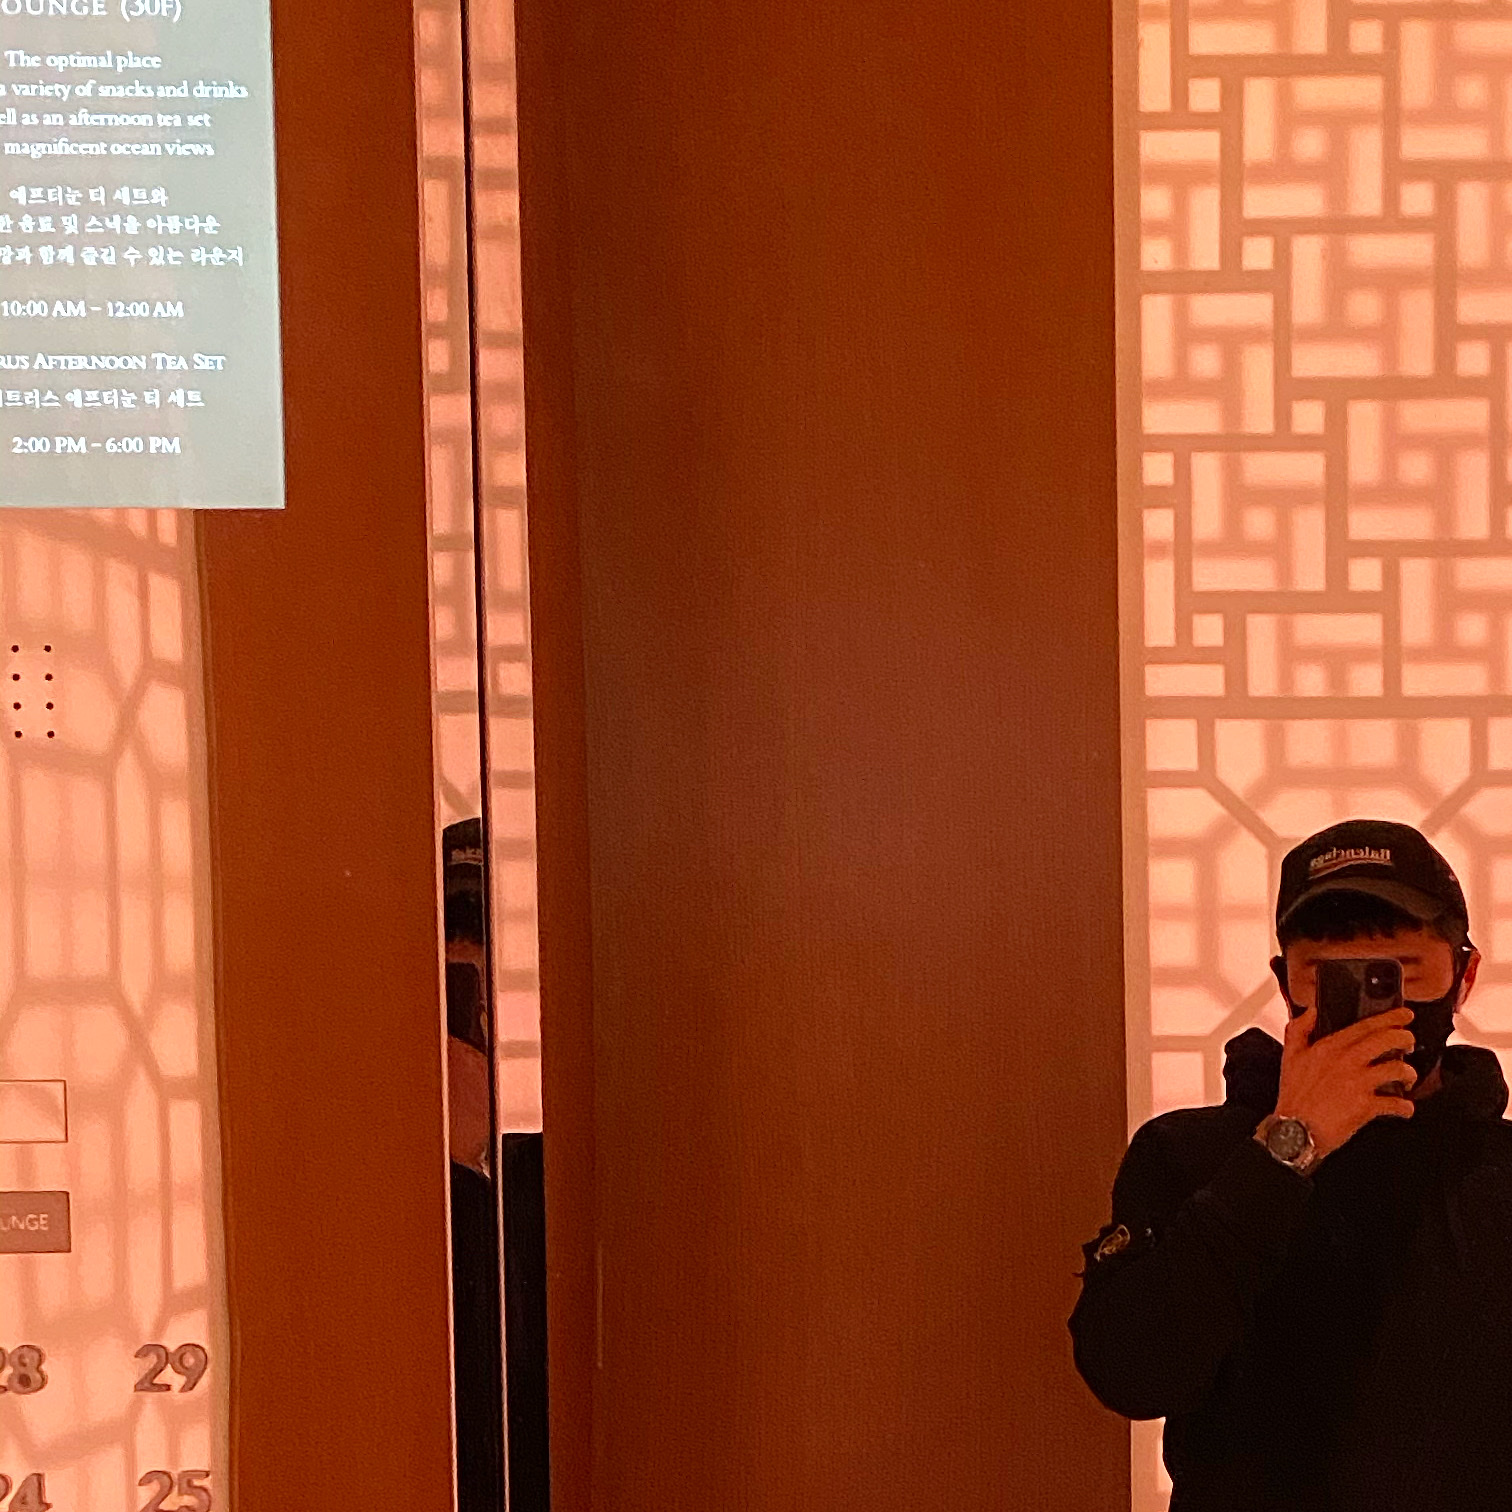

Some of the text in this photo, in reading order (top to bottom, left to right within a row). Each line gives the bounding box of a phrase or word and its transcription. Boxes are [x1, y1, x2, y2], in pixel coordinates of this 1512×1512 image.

[121, 0, 182, 22] (30F)
[4, 50, 161, 72] The optimal place
[12, 80, 71, 101] variety
[75, 80, 96, 97] of
[98, 80, 154, 97] snacks
[157, 81, 188, 98] and
[193, 81, 248, 98] drinks
[22, 113, 39, 126] as
[43, 113, 64, 126] an
[69, 109, 153, 126] afternoon
[157, 113, 181, 127] tea
[187, 113, 211, 127] set
[4, 138, 214, 158] magnificent ocean views
[89, 186, 105, 205] 티
[113, 186, 168, 207] 세트와
[18, 214, 56, 233] 음료
[61, 214, 79, 235] 및
[147, 215, 221, 236] 아름다운
[39, 245, 75, 265] 함께
[80, 246, 117, 266] 즐길
[123, 246, 143, 267] 수
[148, 246, 184, 266] 있는
[191, 246, 243, 266] 라운지
[1, 300, 48, 317] 10:00
[52, 301, 86, 317] AM
[107, 301, 149, 318] 12:00
[152, 301, 184, 317] AM
[33, 352, 146, 370] AFTERNOON
[151, 352, 188, 370] TEA
[193, 353, 226, 370] SET
[0, 389, 61, 408] 트러스
[144, 389, 160, 408] 티
[168, 388, 204, 408] 세트
[12, 437, 50, 453] 2:00
[55, 437, 87, 453] PM
[106, 437, 143, 453] 6:00
[149, 437, 181, 453] PM
[0, 1344, 48, 1395] 8
[133, 1343, 208, 1393] 29
